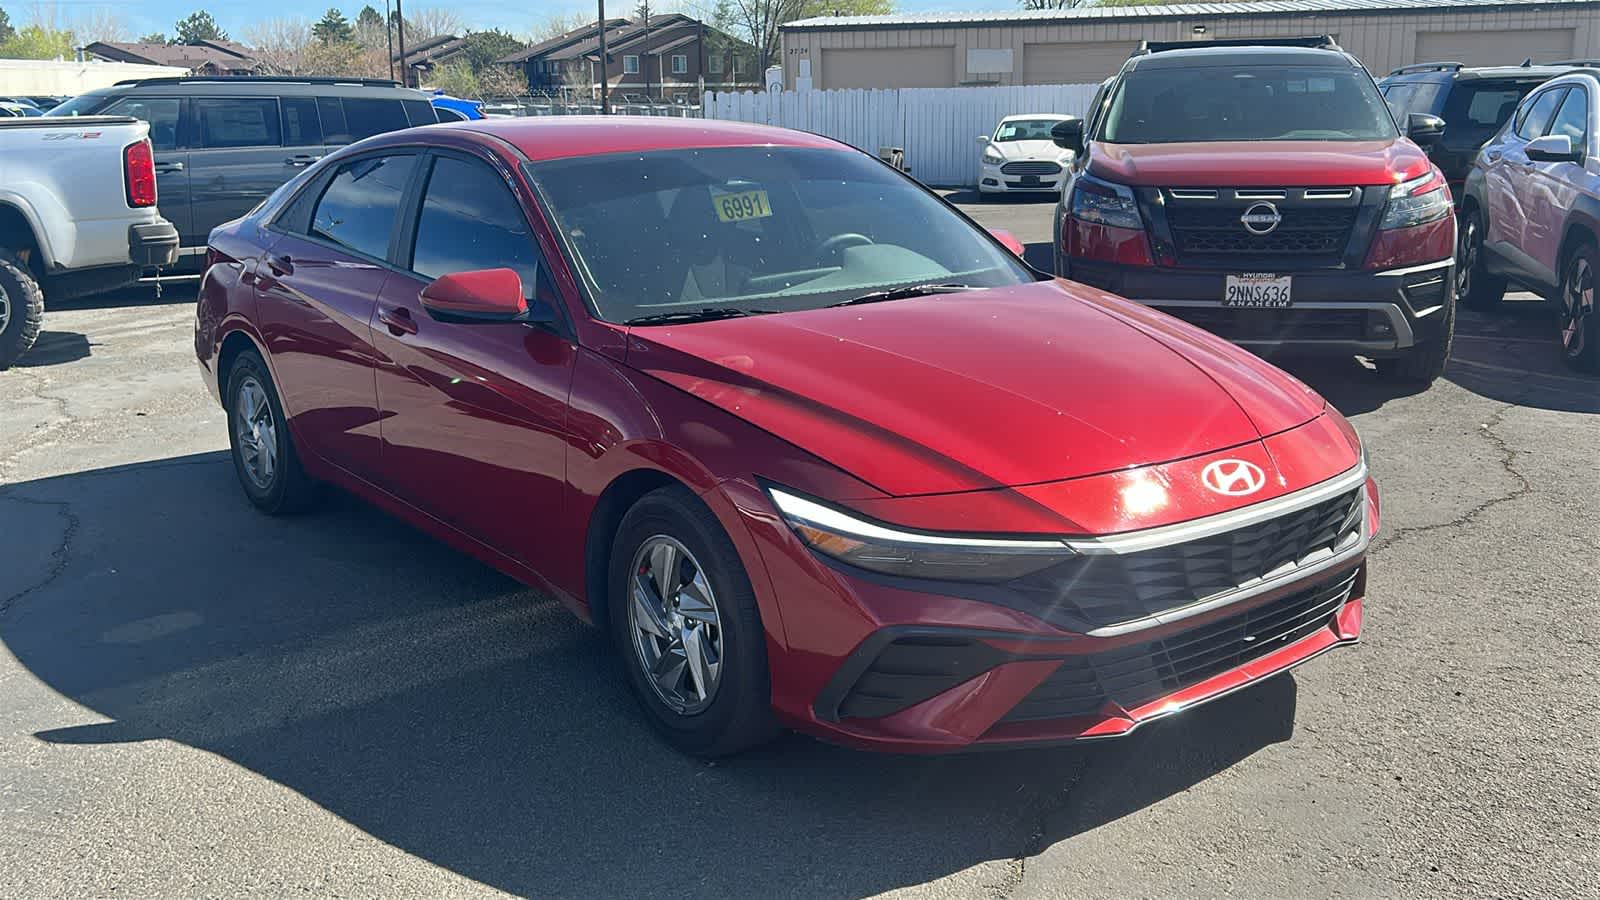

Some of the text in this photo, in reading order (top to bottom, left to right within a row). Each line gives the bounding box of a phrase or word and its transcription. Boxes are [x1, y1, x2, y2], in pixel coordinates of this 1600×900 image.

[722, 193, 763, 219] 6991
[1228, 285, 1289, 302] 9NNS636
[1228, 300, 1287, 308] ANAHEIM
